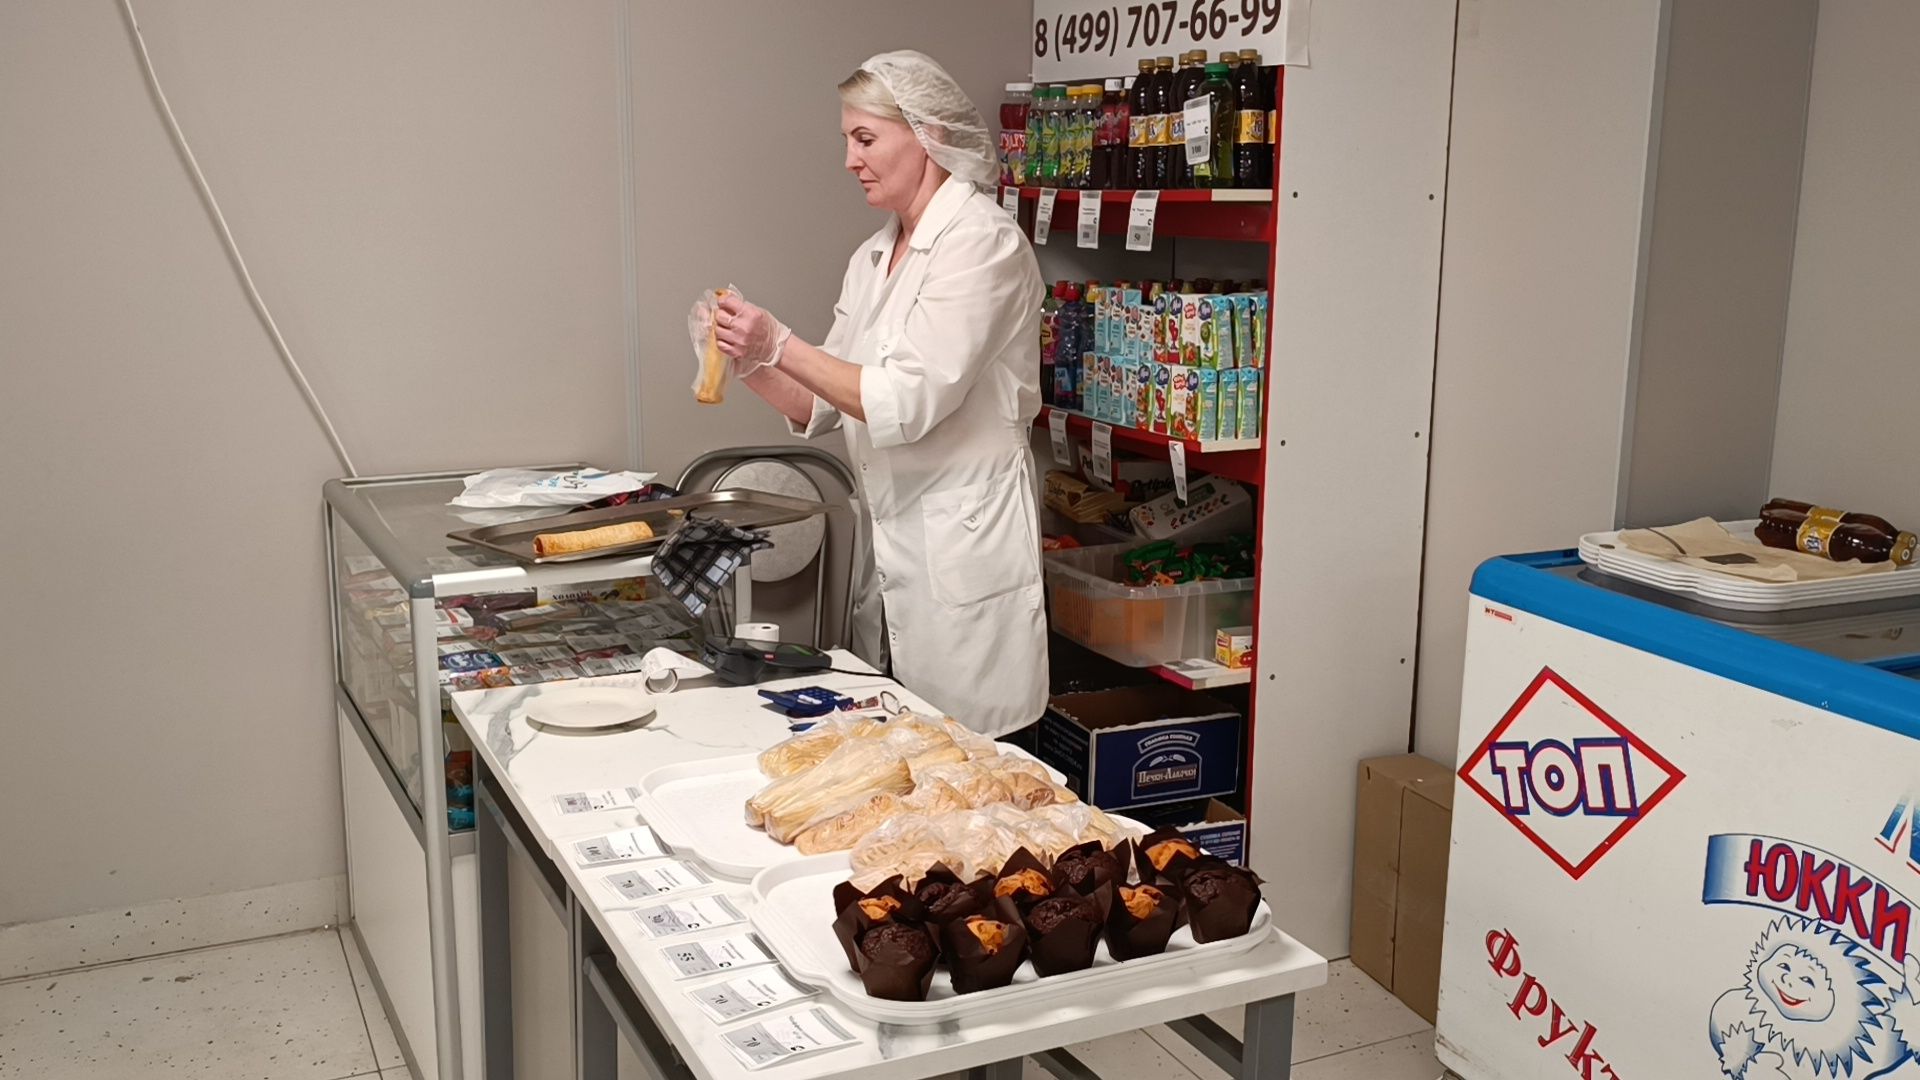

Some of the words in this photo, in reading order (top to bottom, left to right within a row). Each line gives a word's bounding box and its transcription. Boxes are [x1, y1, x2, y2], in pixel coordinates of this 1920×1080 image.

[1034, 19, 1048, 58] 8
[1054, 7, 1119, 62] (499)
[1126, 0, 1282, 48] 707-66-99
[1489, 737, 1640, 817] ТОП
[1744, 838, 1912, 963] ЮККИ
